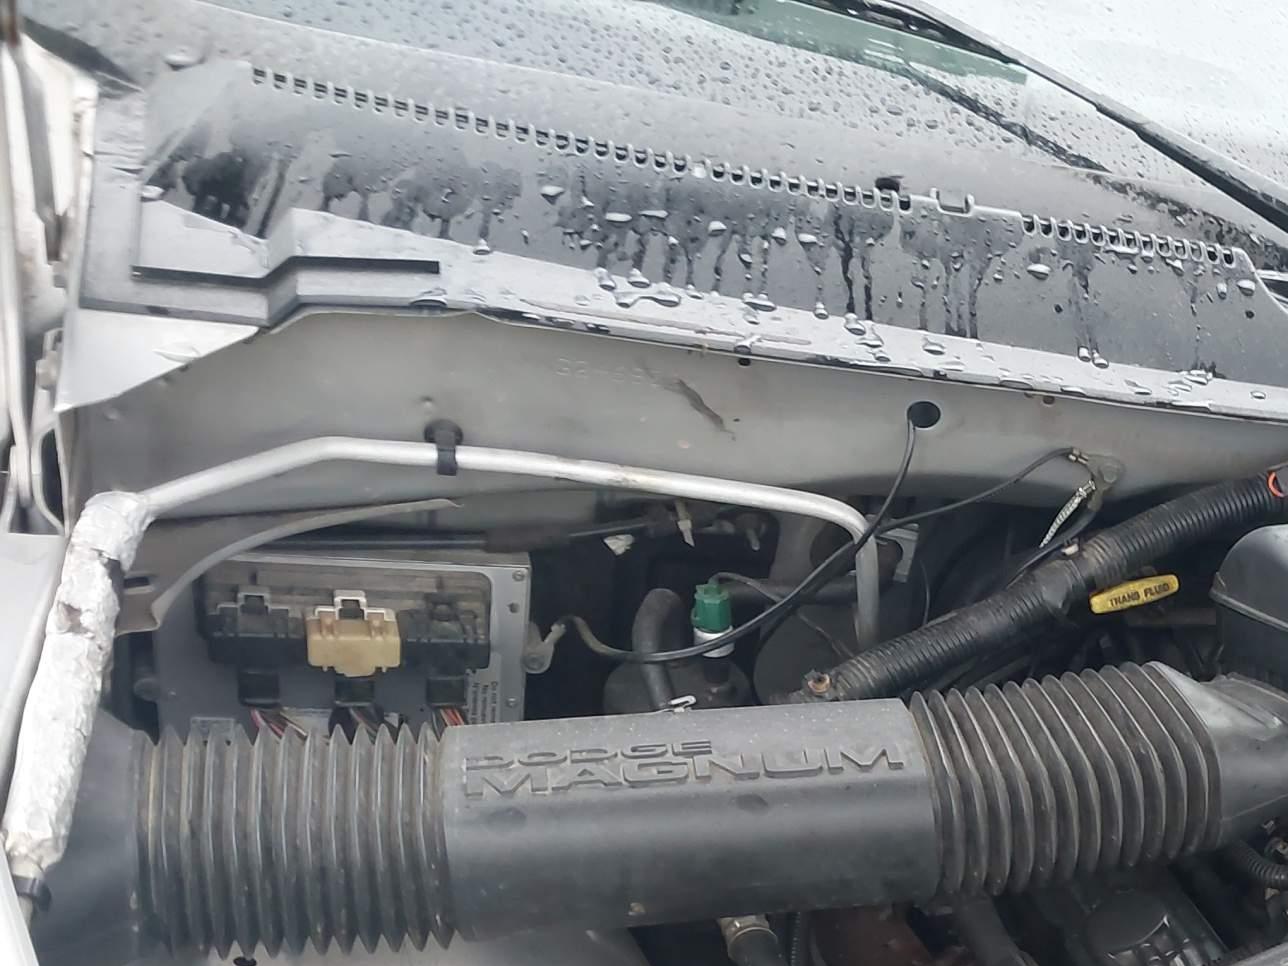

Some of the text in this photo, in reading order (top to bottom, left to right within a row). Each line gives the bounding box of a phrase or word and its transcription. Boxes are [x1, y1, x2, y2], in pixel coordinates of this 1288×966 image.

[1144, 583, 1170, 598] FLUID
[464, 739, 713, 771] DODGE
[463, 747, 905, 797] MAGNUM
